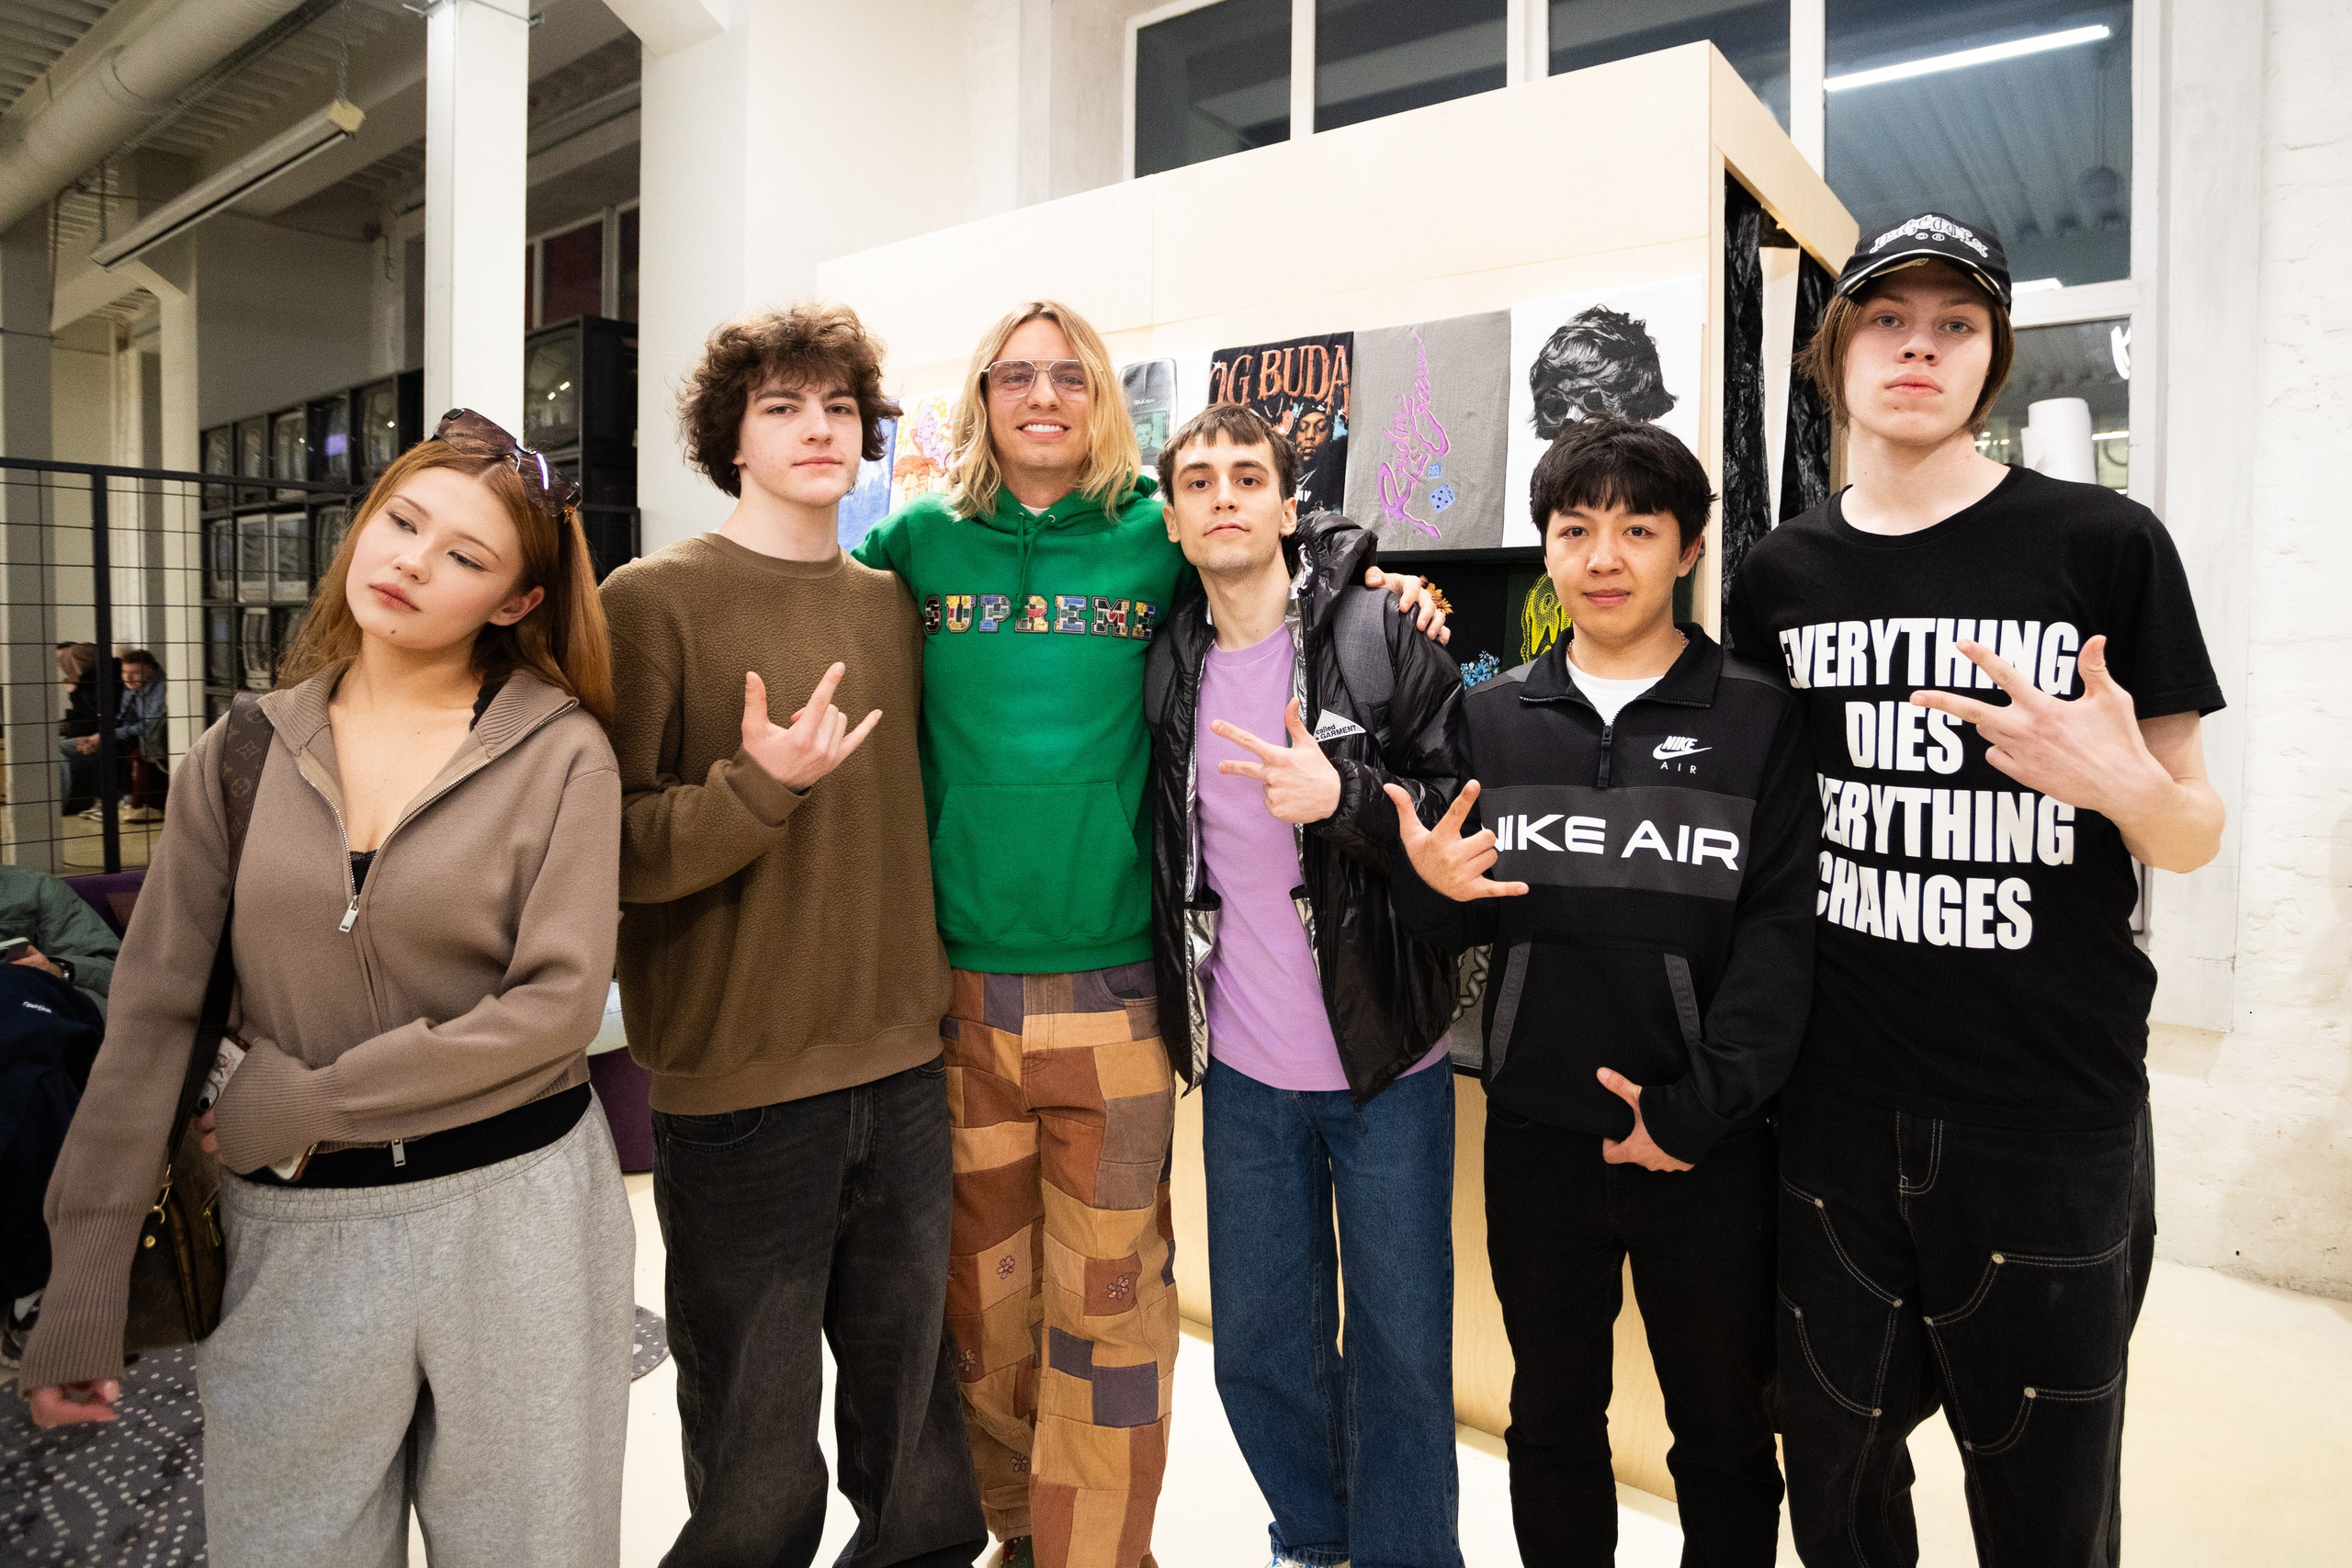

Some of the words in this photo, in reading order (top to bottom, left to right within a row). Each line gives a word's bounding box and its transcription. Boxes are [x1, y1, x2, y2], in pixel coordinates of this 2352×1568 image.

[1258, 344, 1351, 418] BUDA
[923, 593, 1158, 641] SUPREME
[1779, 617, 2080, 696] EVERYTHING
[1316, 724, 1336, 735] called
[1320, 725, 1357, 739] GARMENT
[1662, 735, 1698, 751] NIKE
[1845, 701, 1964, 774] DIES
[1660, 761, 1697, 774] AIR
[1621, 819, 1740, 871] AIR
[1816, 773, 2076, 866] VERYTHING
[1815, 850, 2033, 951] CHANGES
